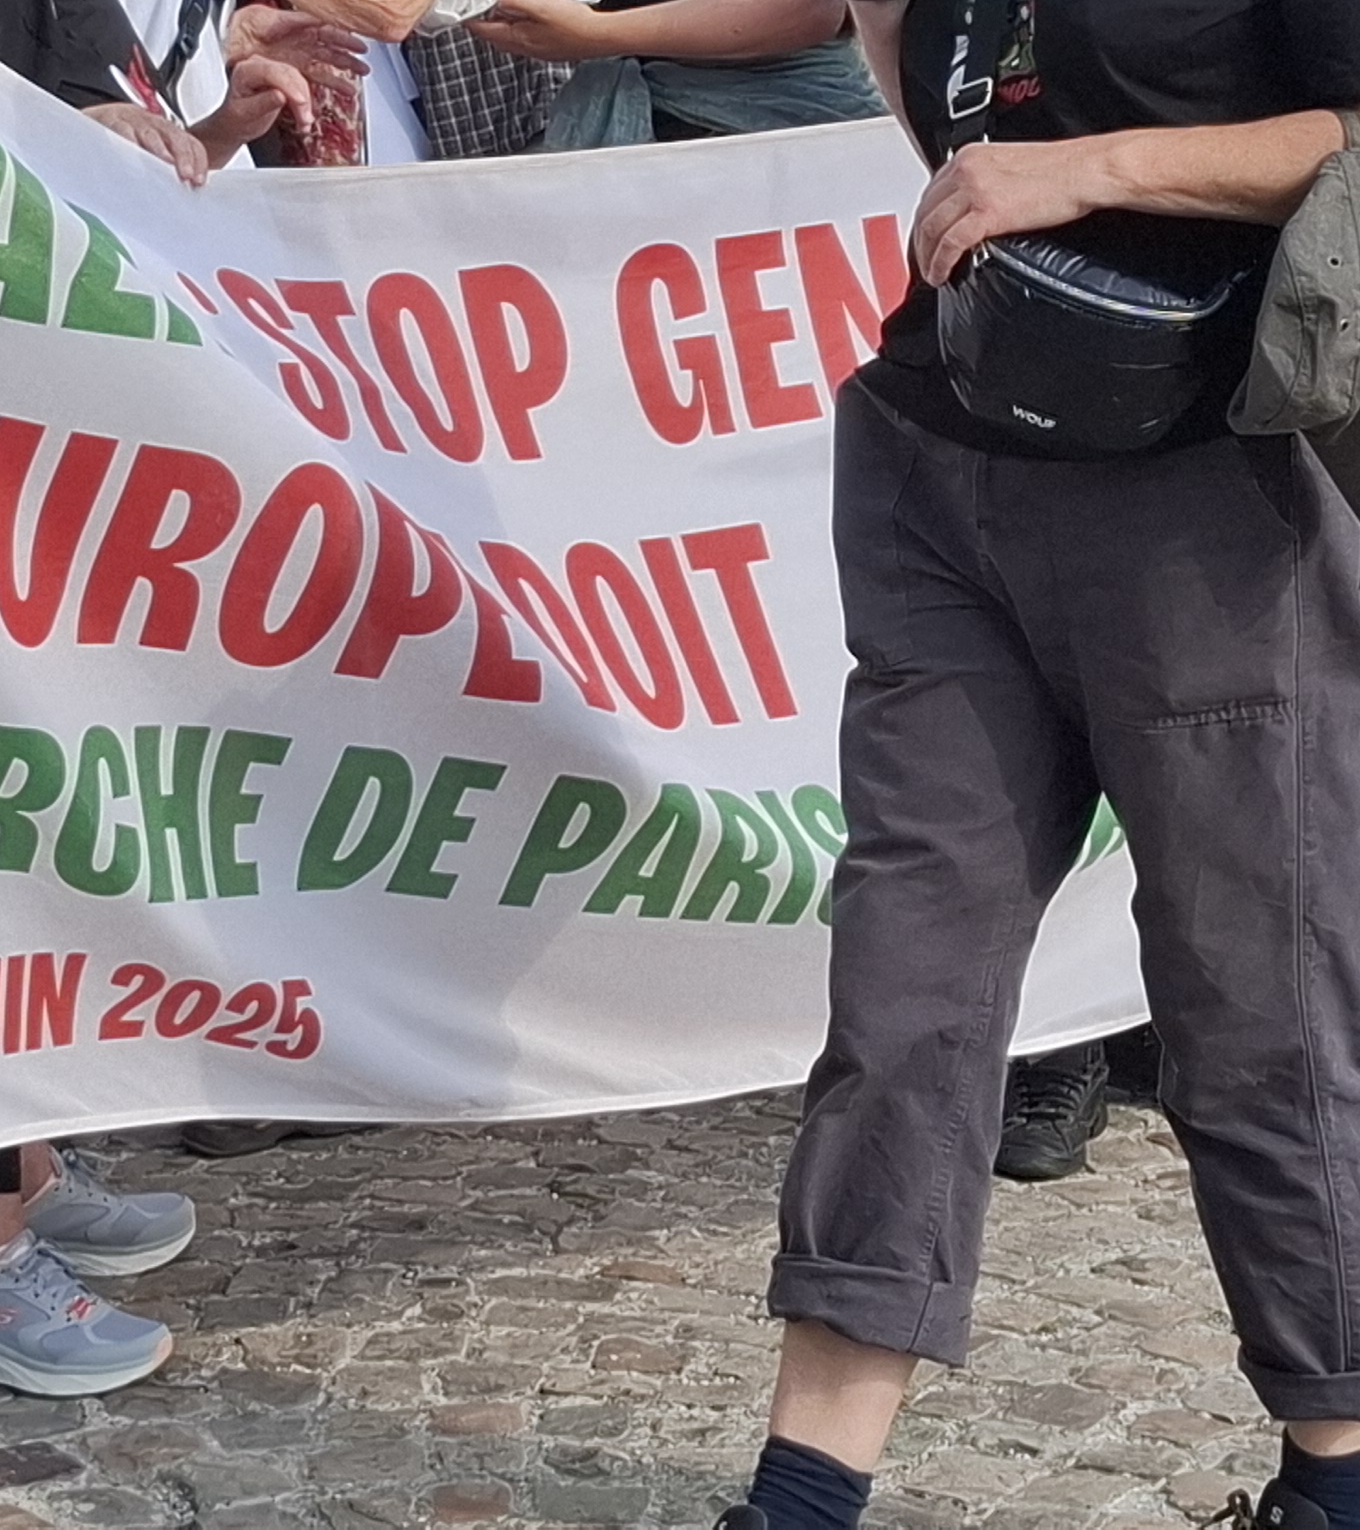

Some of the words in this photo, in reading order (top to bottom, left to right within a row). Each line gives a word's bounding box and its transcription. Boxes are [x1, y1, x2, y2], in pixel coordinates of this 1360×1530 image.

[216, 263, 569, 463] STOP
[479, 523, 799, 730] DOIT
[296, 744, 507, 900] DE
[500, 772, 849, 927] PARIS
[98, 963, 322, 1060] 2025
